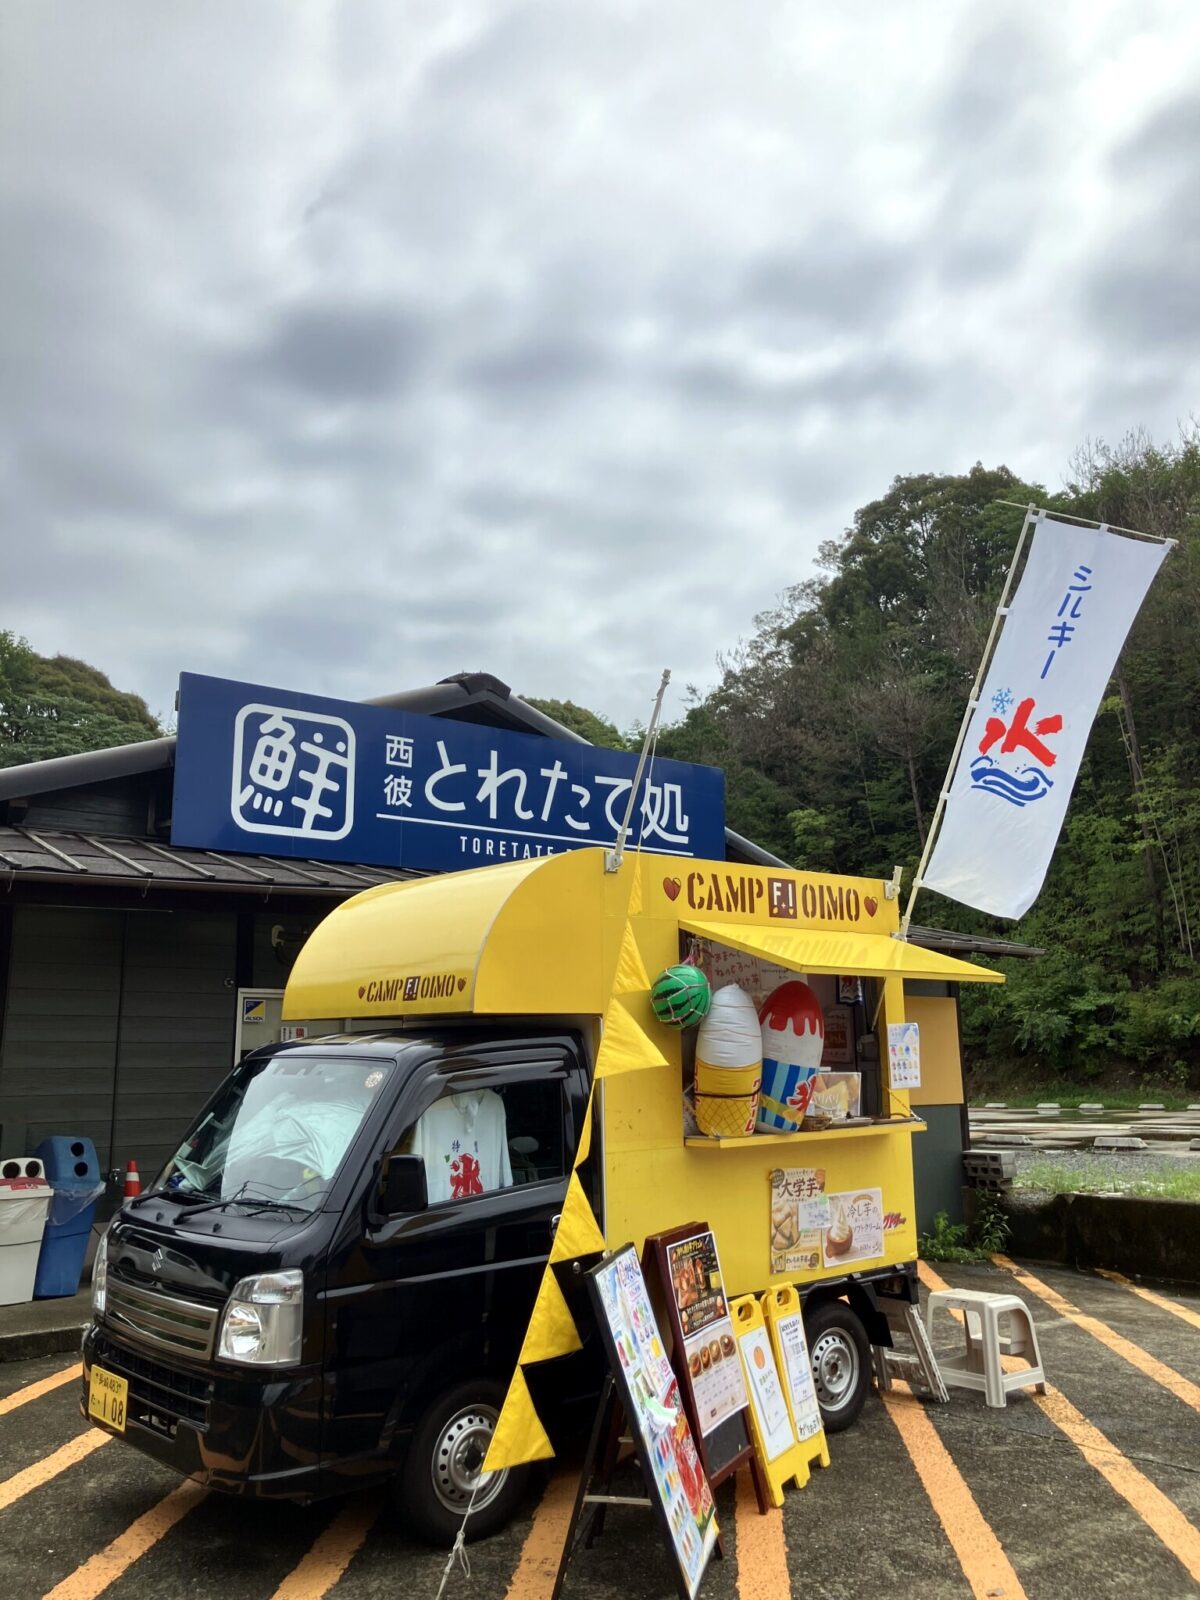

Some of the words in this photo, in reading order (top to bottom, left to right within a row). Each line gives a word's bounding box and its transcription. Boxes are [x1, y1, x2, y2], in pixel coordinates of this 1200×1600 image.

[1040, 565, 1093, 679] ミルキー
[383, 734, 414, 809] 西彼
[424, 740, 691, 845] とれたて処
[687, 872, 764, 914] CAMP
[802, 883, 861, 922] OIMO
[366, 979, 404, 1002] CAMP
[420, 974, 455, 999] OIMO
[779, 1177, 817, 1198] 大学芋
